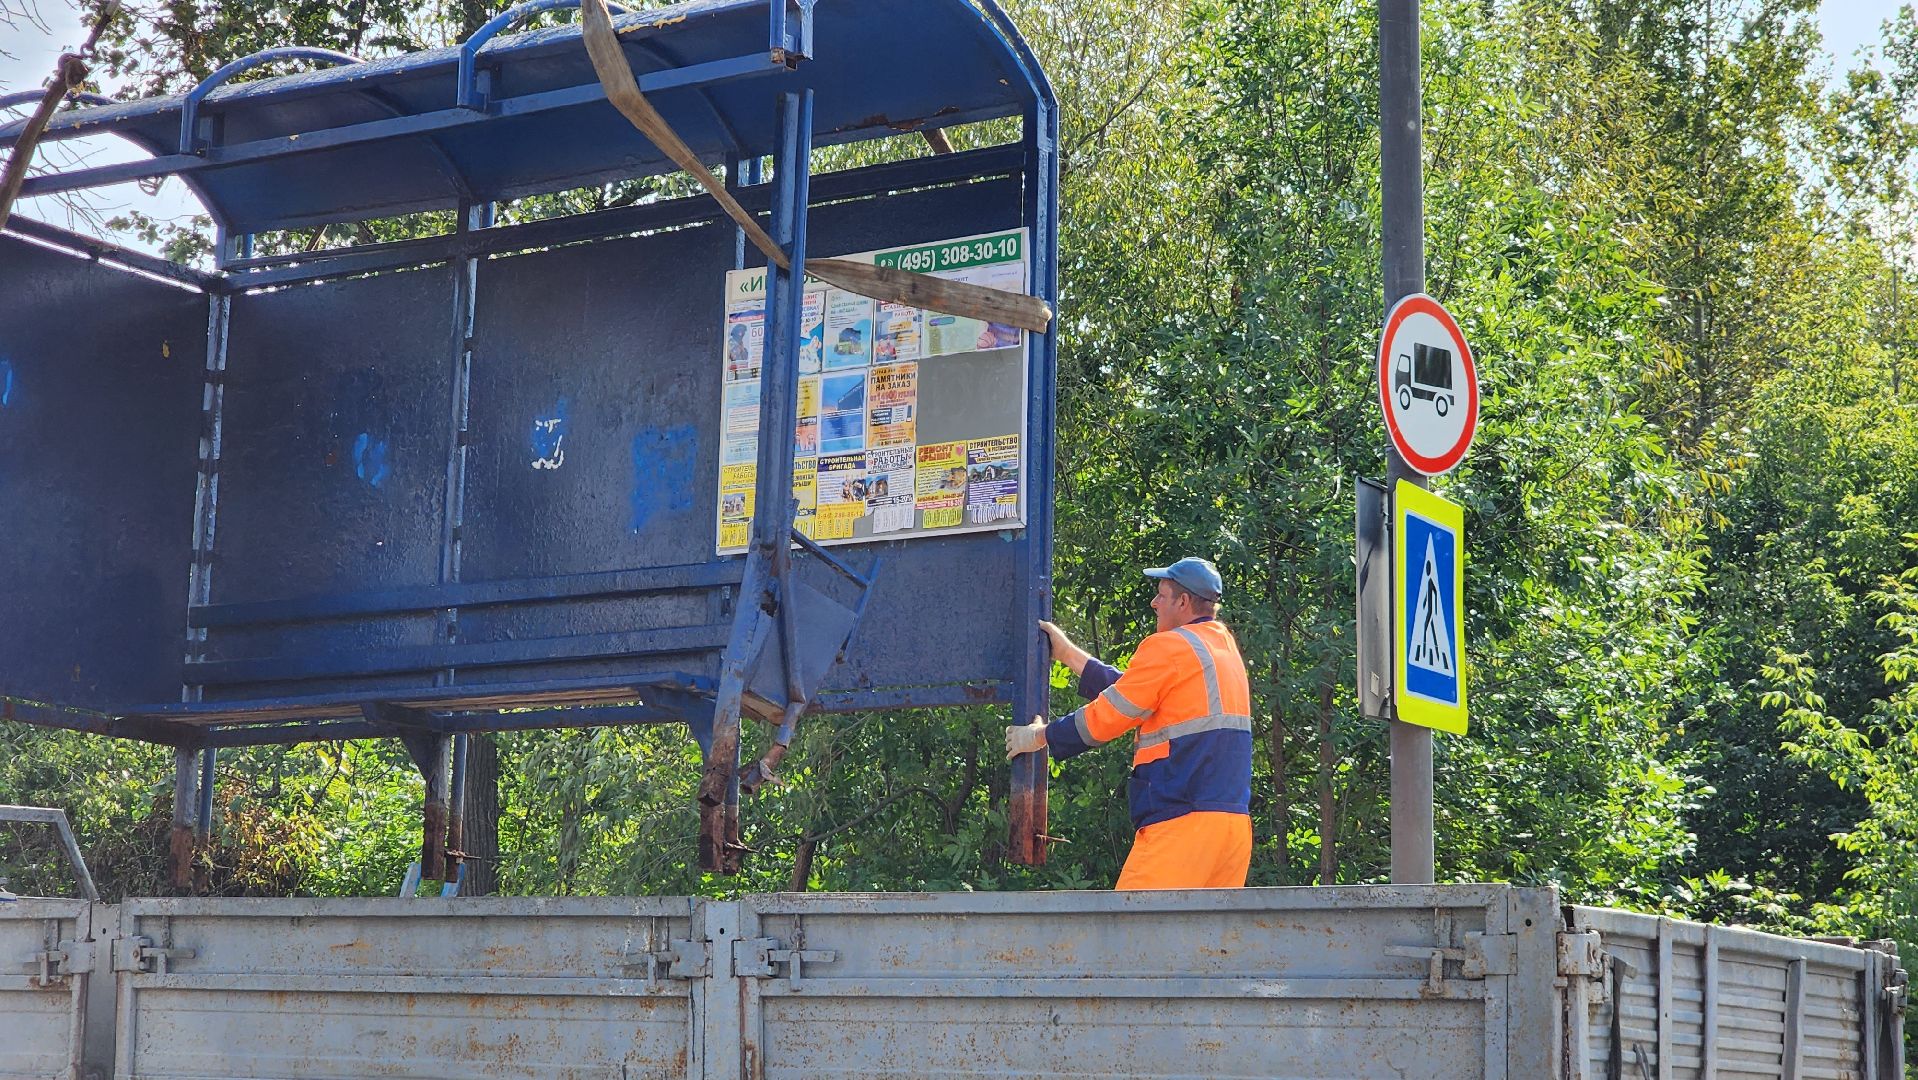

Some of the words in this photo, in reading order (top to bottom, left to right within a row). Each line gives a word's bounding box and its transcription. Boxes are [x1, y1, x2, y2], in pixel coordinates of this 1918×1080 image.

[897, 250, 936, 271] (495)
[940, 238, 1017, 266] 308-30-10
[870, 371, 916, 384] ПАМЯТНИКИ
[875, 383, 886, 391] НА
[888, 380, 911, 389] ЗАКАЗ
[969, 436, 1018, 449] СТРОИТЕЛЬСТВО
[819, 455, 866, 465] СТРОИТЕЛЬНАЯ
[873, 453, 909, 465] РАБОТЫ
[828, 463, 856, 471] БРИГАДА
